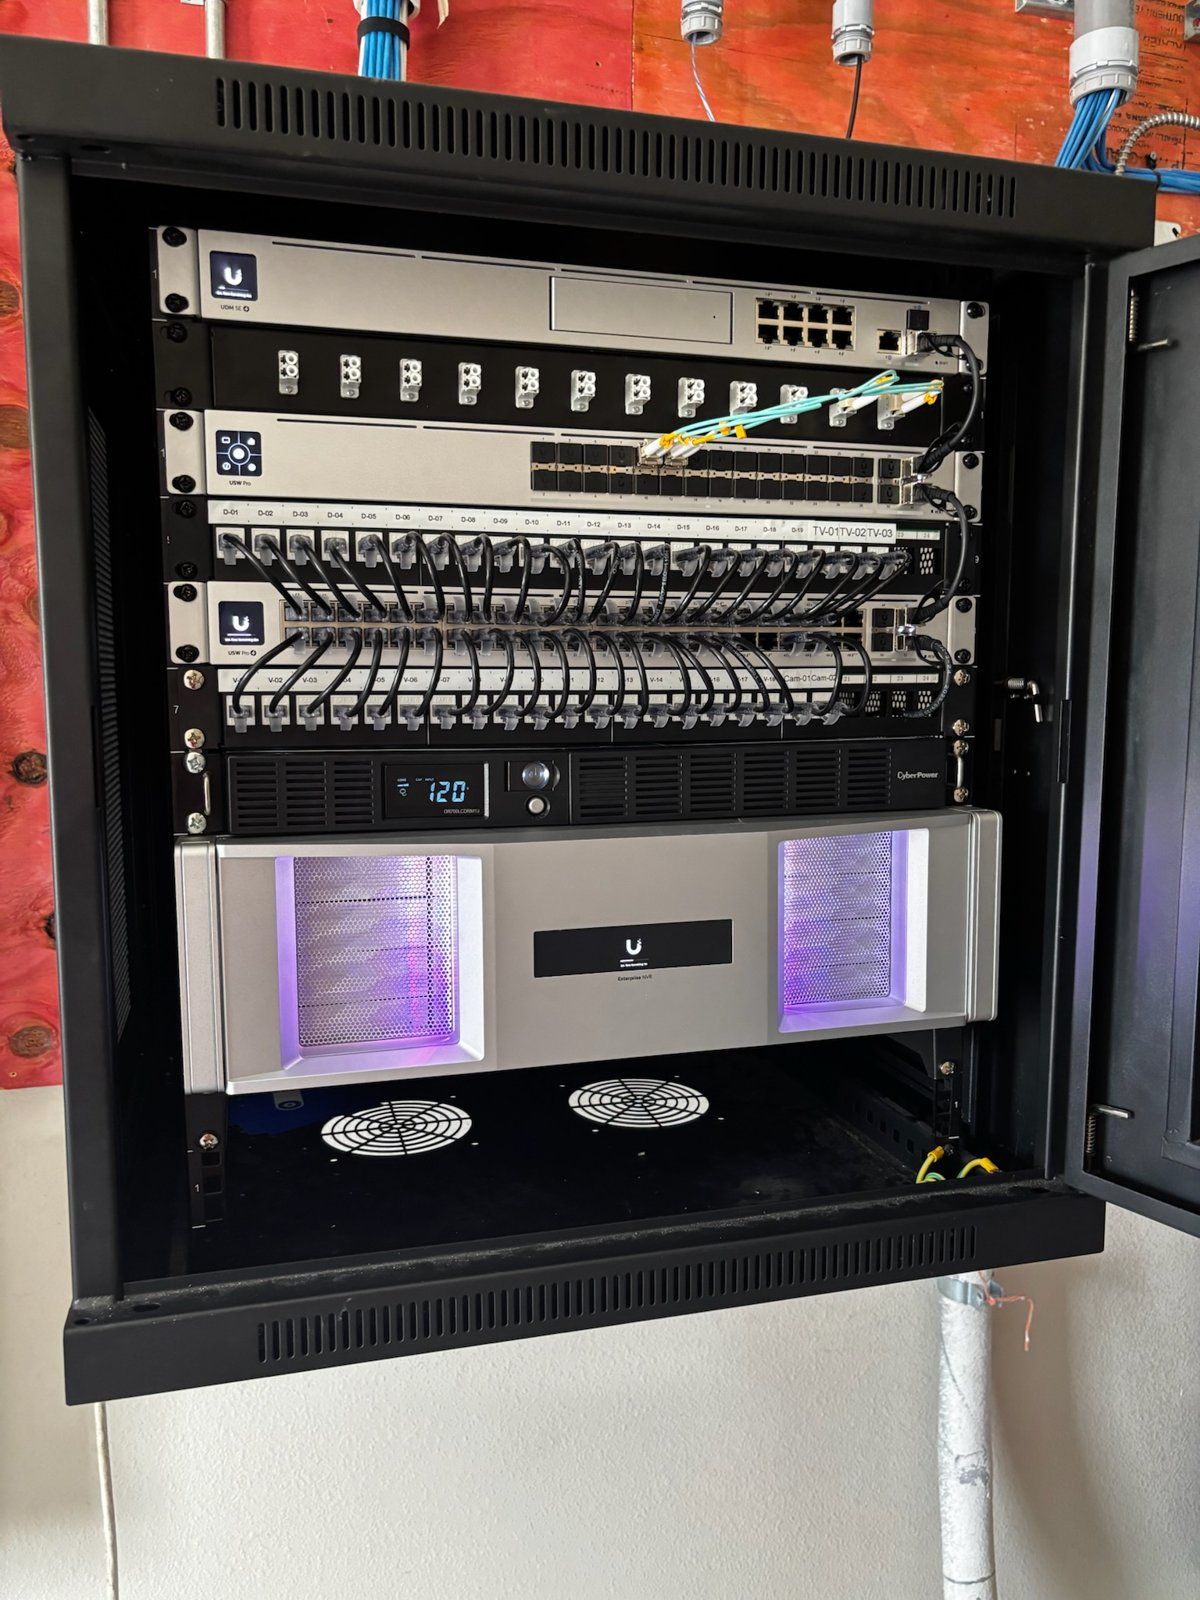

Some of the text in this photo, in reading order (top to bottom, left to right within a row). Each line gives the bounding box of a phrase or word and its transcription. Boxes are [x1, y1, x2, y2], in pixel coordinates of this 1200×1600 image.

[813, 525, 893, 539] TV-01 TV-02 TV-03
[784, 675, 810, 683] Cam-01
[173, 705, 180, 714] 7
[897, 771, 938, 781] CyberPower
[429, 780, 466, 803] 120
